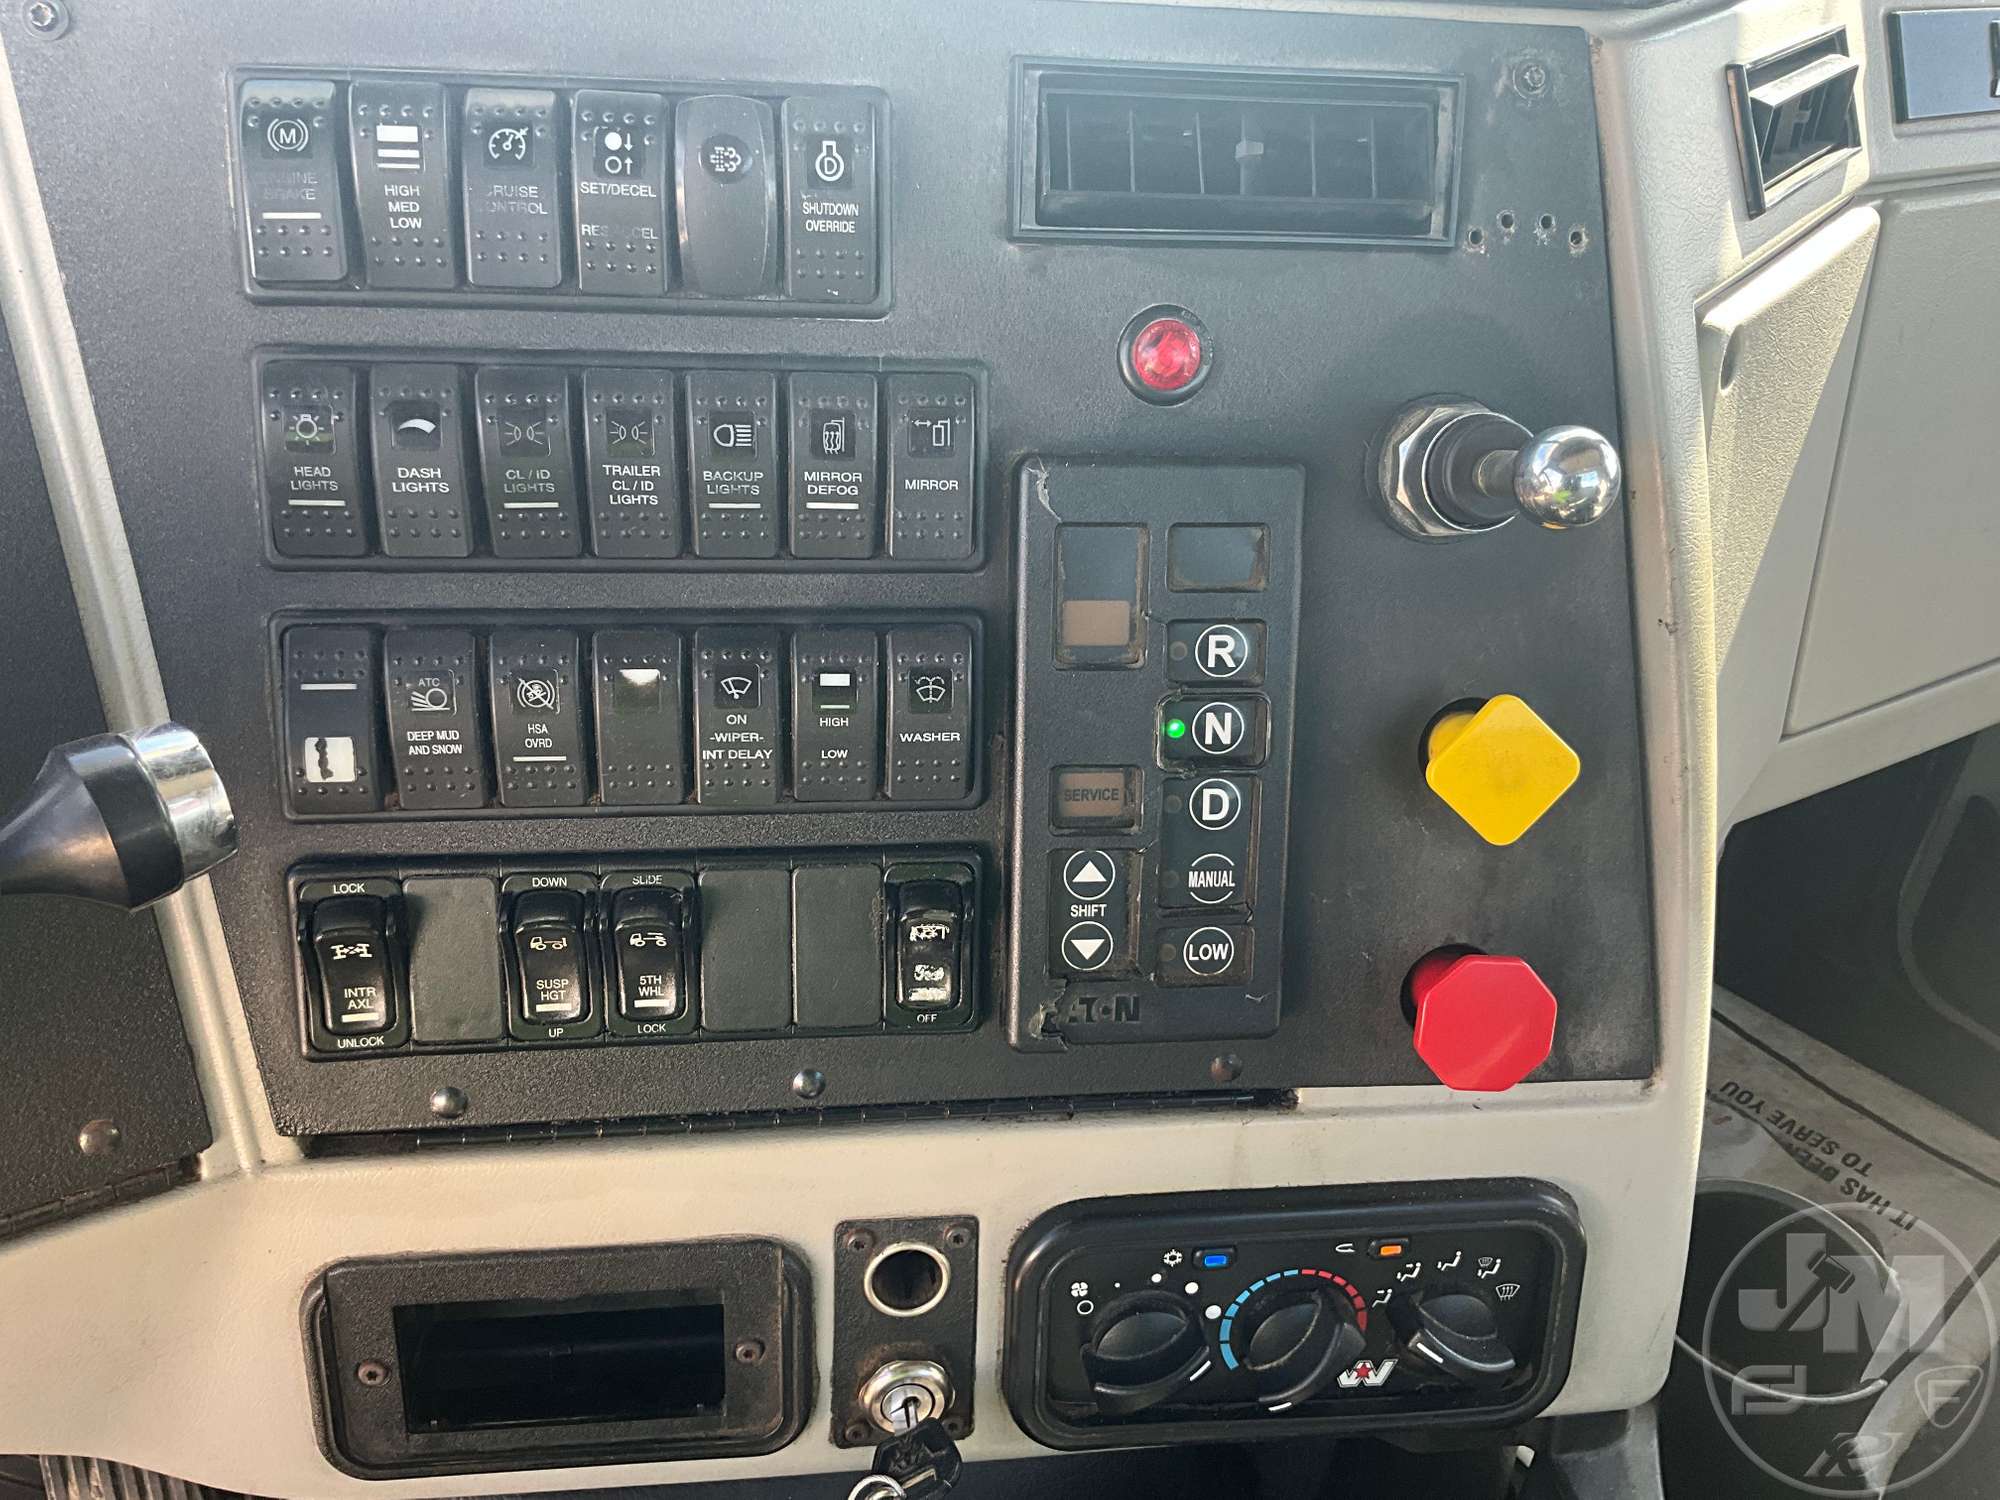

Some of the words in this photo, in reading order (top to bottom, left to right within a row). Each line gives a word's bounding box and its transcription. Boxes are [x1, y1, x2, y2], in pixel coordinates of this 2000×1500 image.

[384, 184, 421, 197] HIGH
[580, 181, 657, 198] SET/DECEL
[388, 201, 421, 213] MED
[802, 202, 860, 217] SHUTDOWN
[390, 216, 423, 229] LOW
[805, 219, 856, 233] OVERRIDE
[294, 466, 332, 478] HEAD
[397, 467, 442, 479] DASH
[602, 464, 661, 477] TRAILER
[703, 470, 764, 483] BACKUP
[804, 471, 863, 483] MIRROR
[290, 480, 339, 492] LIGHTS
[392, 482, 450, 494] LIGHTS
[504, 482, 556, 494] LIGHTS
[707, 483, 760, 496] LIGHTS
[807, 484, 859, 496] DEFOG
[904, 479, 960, 491] MIRROR
[609, 494, 659, 506] LIGHTS
[1207, 634, 1237, 668] R
[418, 677, 441, 688] ATC
[726, 713, 747, 726] ON
[819, 716, 849, 728] HIGH
[527, 723, 549, 735] HSA
[1204, 711, 1233, 746] N
[407, 730, 434, 742] DEEP
[436, 729, 460, 741] MUD
[899, 731, 961, 744] WASHER
[408, 744, 431, 756] AND
[432, 743, 463, 755] SNOW
[524, 738, 553, 749] OVRD
[702, 750, 726, 760] INT
[728, 749, 773, 760] DELAY
[821, 749, 848, 760] LOW
[1063, 788, 1119, 802] SERVICE
[1201, 787, 1230, 821] D
[531, 876, 568, 888] DOWN
[632, 874, 663, 886] SLIDE
[1188, 870, 1236, 889] MANUAL
[333, 882, 366, 894] LOCK
[1070, 903, 1107, 918] SHIFT
[1188, 943, 1229, 961] LOW
[535, 978, 570, 991] SUSP
[639, 975, 662, 986] 5TH
[343, 986, 377, 999] INTR
[540, 990, 567, 1002] HGT
[638, 986, 665, 998] WHL
[347, 998, 375, 1011] AXL
[916, 1013, 938, 1024] OFF
[548, 1027, 564, 1039] UP
[637, 1023, 667, 1034] LOCK
[337, 1035, 385, 1048] UNLOCK
[1719, 1081, 1766, 1115] YOU
[1767, 1109, 1841, 1156] SERVE
[1840, 1151, 1874, 1178] TO
[1839, 1177, 1891, 1216] HAS
[1888, 1208, 1920, 1232] IT
